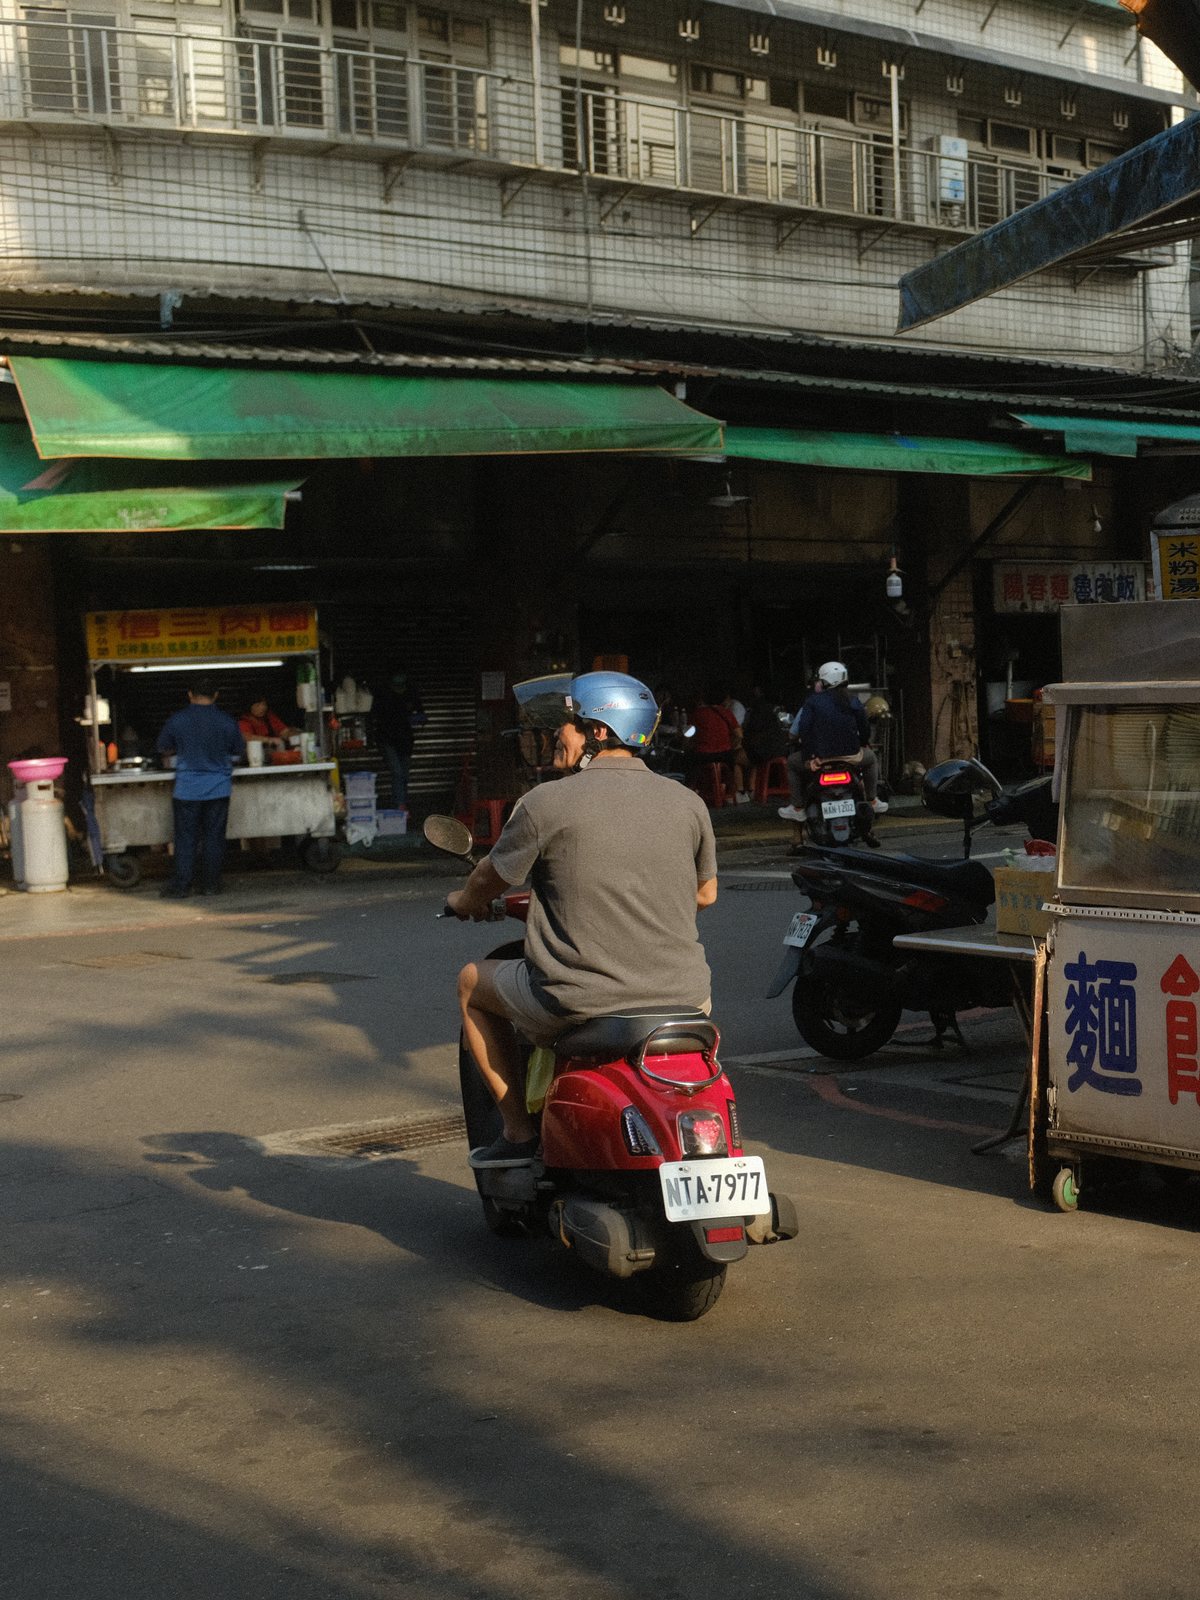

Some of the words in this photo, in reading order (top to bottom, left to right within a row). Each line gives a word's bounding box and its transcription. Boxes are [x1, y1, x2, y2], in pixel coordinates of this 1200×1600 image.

[1168, 541, 1200, 594] 米粉湯
[1063, 950, 1143, 1097] 麵
